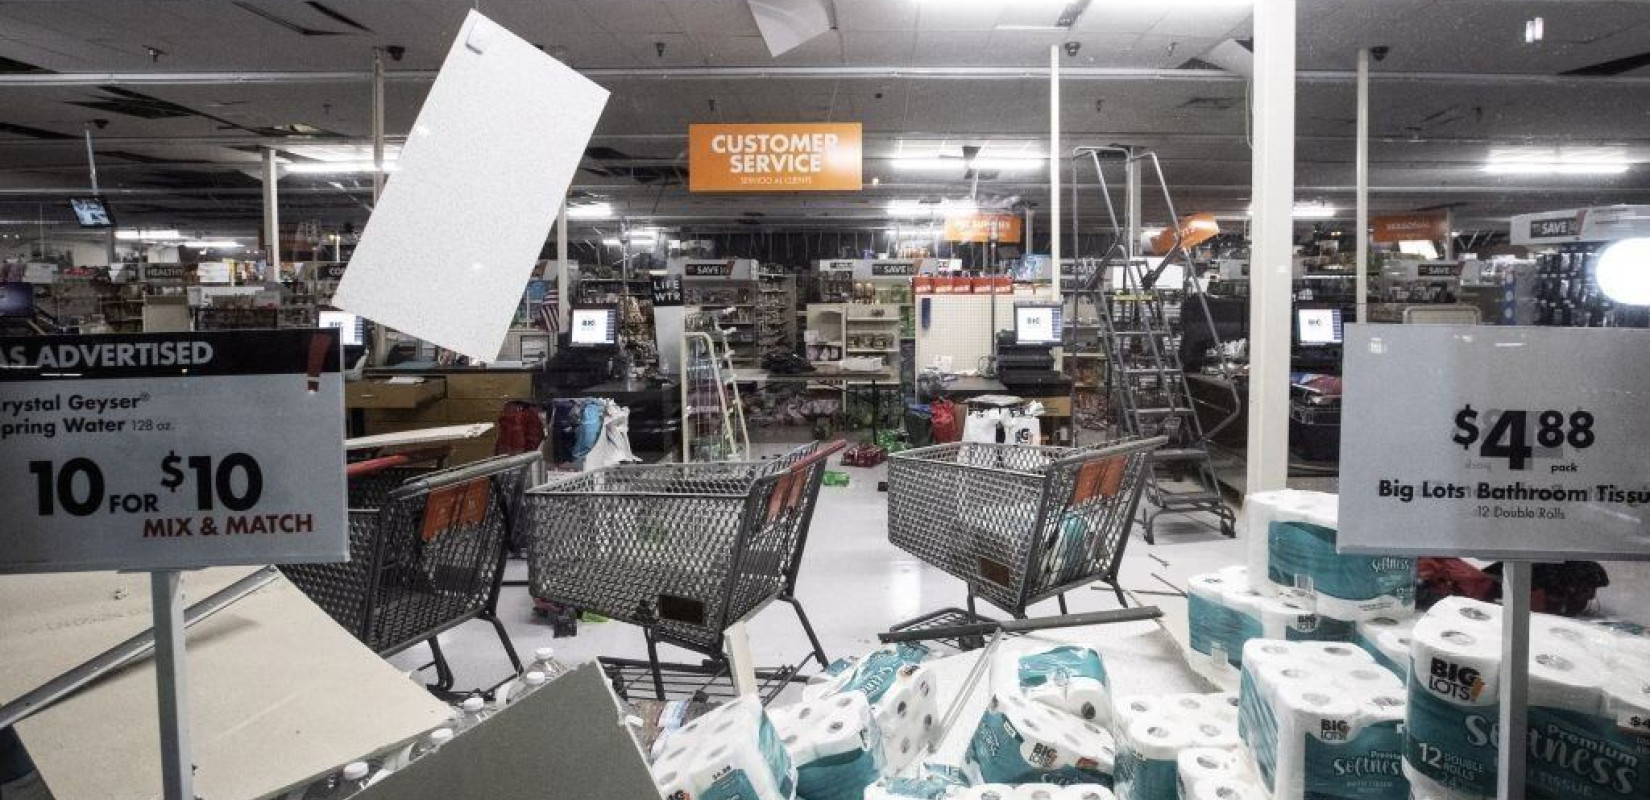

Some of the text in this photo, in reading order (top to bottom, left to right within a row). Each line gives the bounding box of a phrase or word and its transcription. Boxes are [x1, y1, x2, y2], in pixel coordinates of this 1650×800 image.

[711, 133, 839, 153] CUSTOMER
[729, 154, 821, 173] SERVICE
[1541, 220, 1567, 235] SAVE
[697, 265, 719, 275] SAVE
[884, 265, 906, 274] SAVE
[653, 279, 679, 291] LIFE
[654, 292, 681, 302] WTR
[37, 341, 214, 368] ADVERTISED
[0, 394, 61, 417] rystal
[0, 418, 56, 439] pring
[63, 417, 126, 433] Water
[131, 420, 154, 431] 128
[1551, 462, 1578, 474] pack
[29, 450, 264, 516] 10 FOR $10
[1378, 480, 1650, 505] Big Lots Bathroom Tissu
[1477, 506, 1566, 519] 12 Double Rolls
[143, 513, 314, 538] MIX & MATCH
[1430, 657, 1480, 686] BIG
[1428, 674, 1470, 700] LOTS
[1321, 719, 1347, 731] BIG
[1033, 742, 1058, 760] BIG
[1418, 742, 1443, 769] 12
[1548, 724, 1638, 767] Premium
